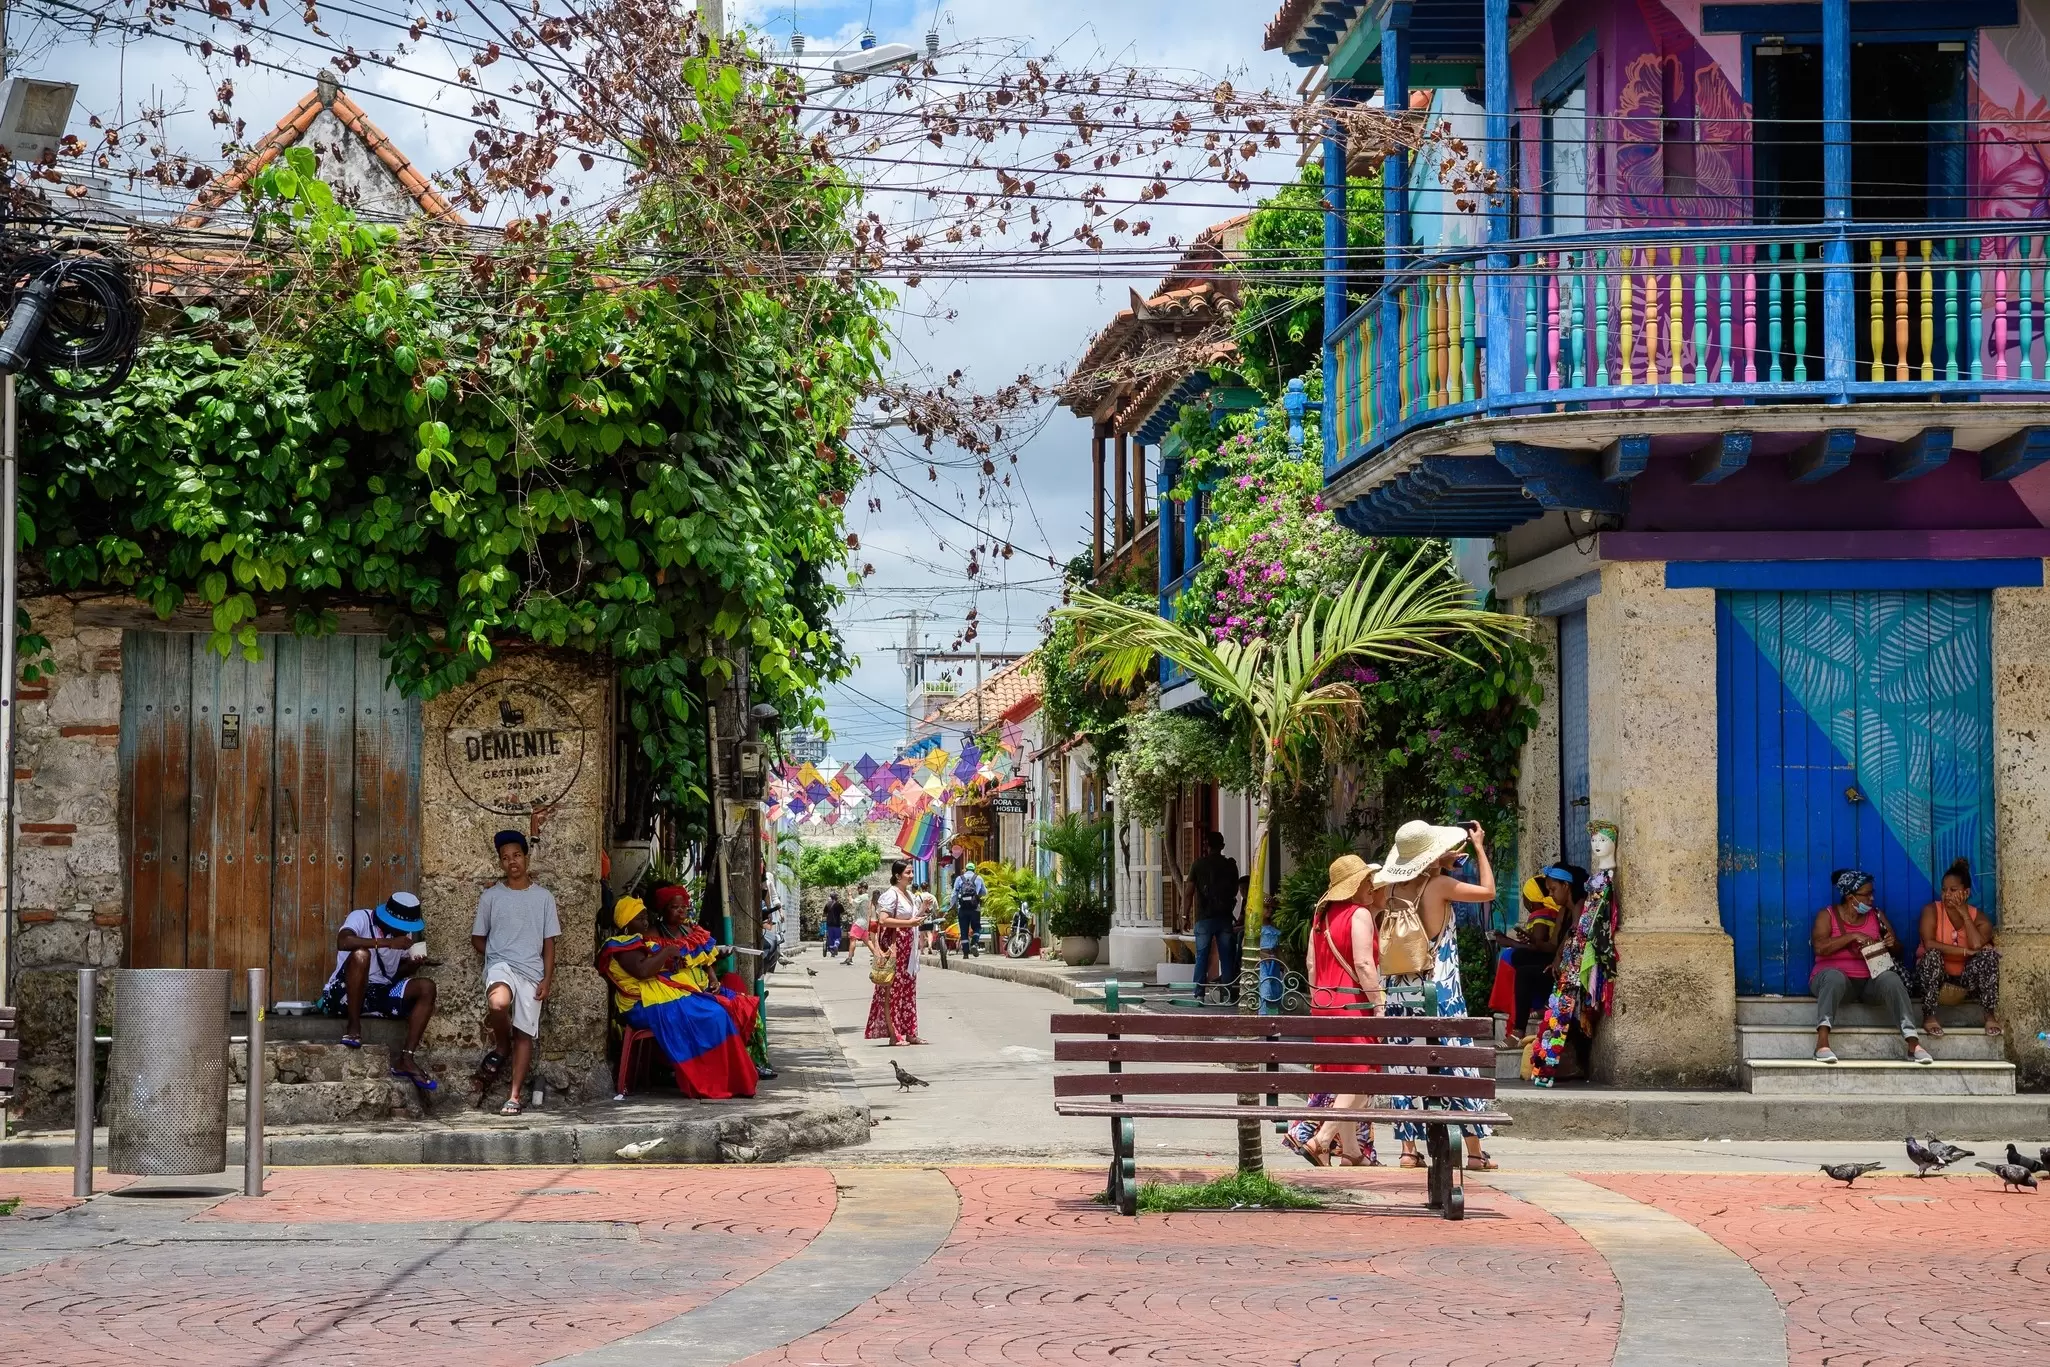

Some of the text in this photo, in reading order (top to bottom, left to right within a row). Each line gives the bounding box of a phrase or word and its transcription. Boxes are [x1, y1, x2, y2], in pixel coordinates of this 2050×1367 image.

[457, 698, 481, 725] PLAZA
[483, 688, 497, 699] DE
[465, 730, 561, 762] DEMENTE
[493, 801, 524, 811] TAPAS
